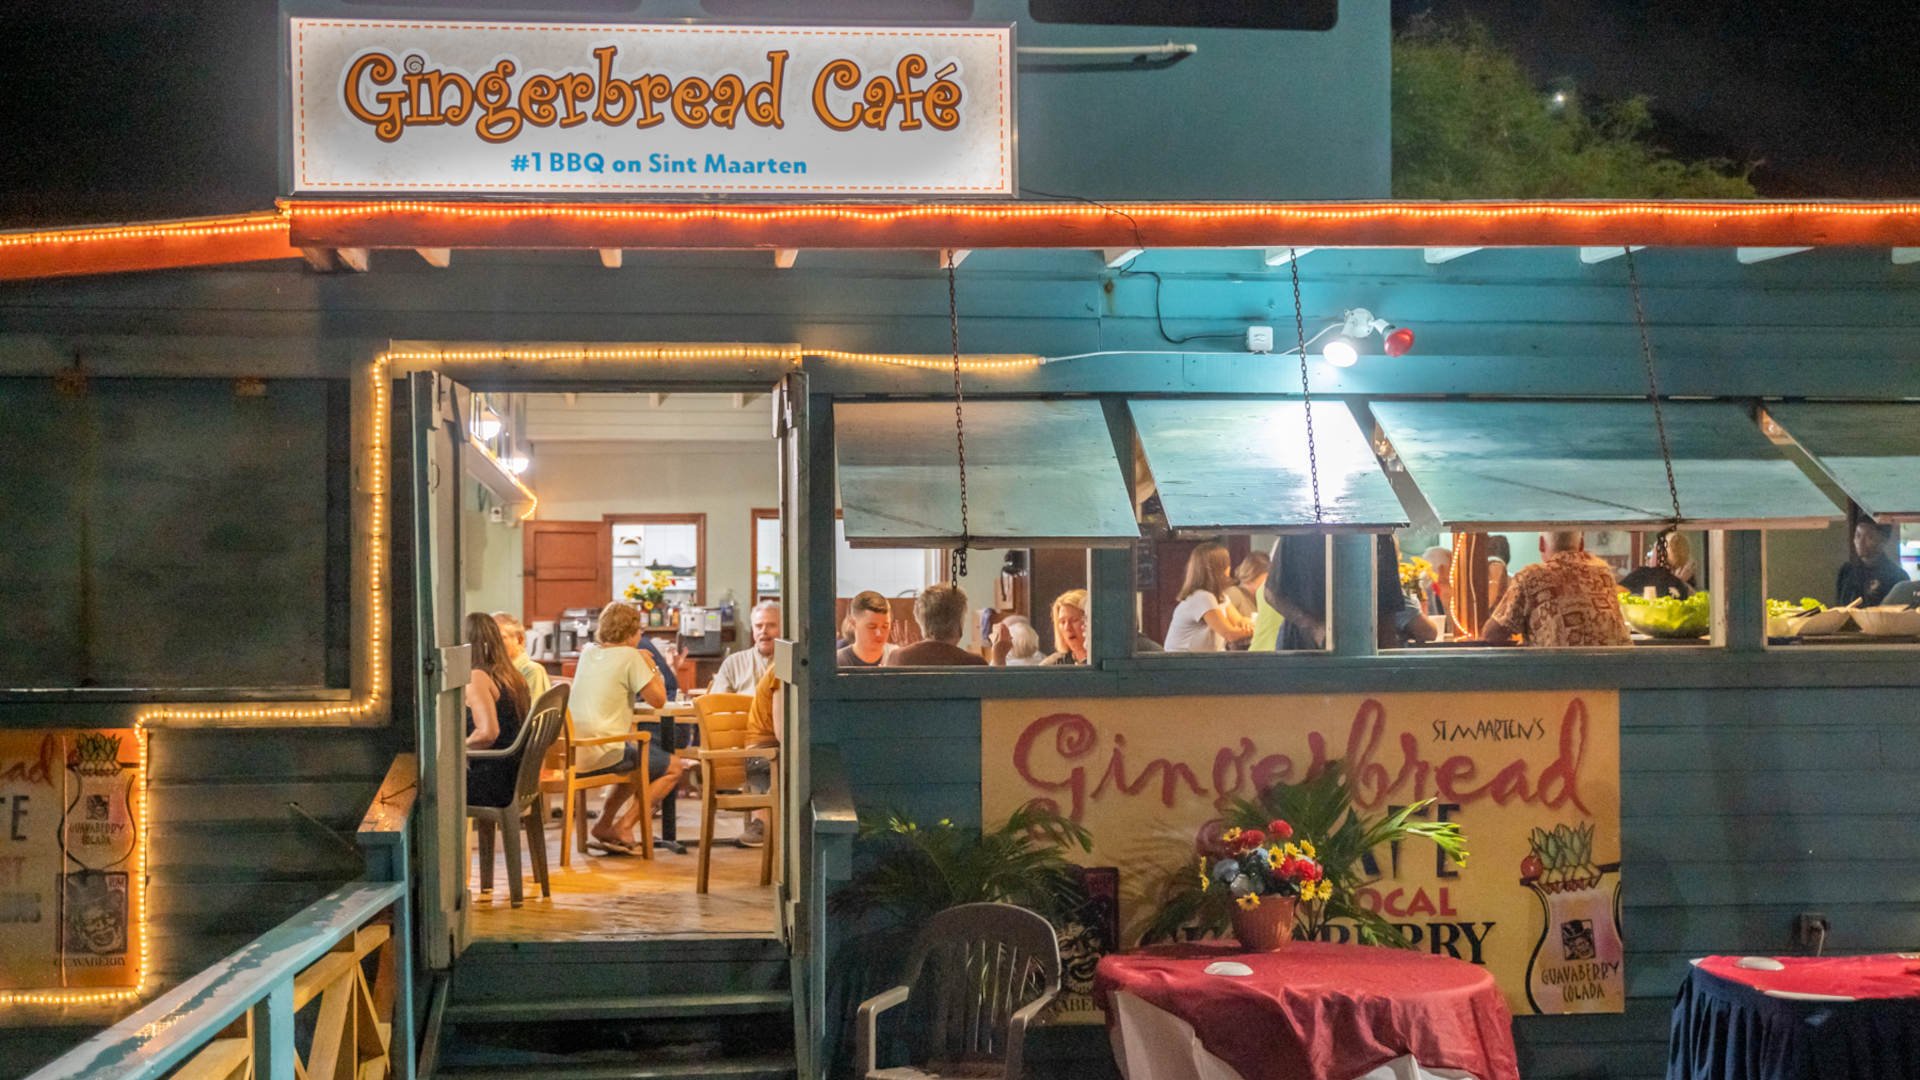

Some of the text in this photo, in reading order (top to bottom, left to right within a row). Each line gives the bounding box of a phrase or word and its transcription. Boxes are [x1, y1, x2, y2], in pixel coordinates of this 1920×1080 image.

[344, 45, 964, 144] Gingerbread Café
[510, 152, 807, 174] #1 BBQ on Sint Maarten
[1432, 719, 1447, 742] ST
[1012, 698, 1592, 860] Gingerbread
[1353, 887, 1457, 917] OCAL
[1541, 962, 1619, 985] GUAVABERRY
[1563, 982, 1605, 1002] COLADA
